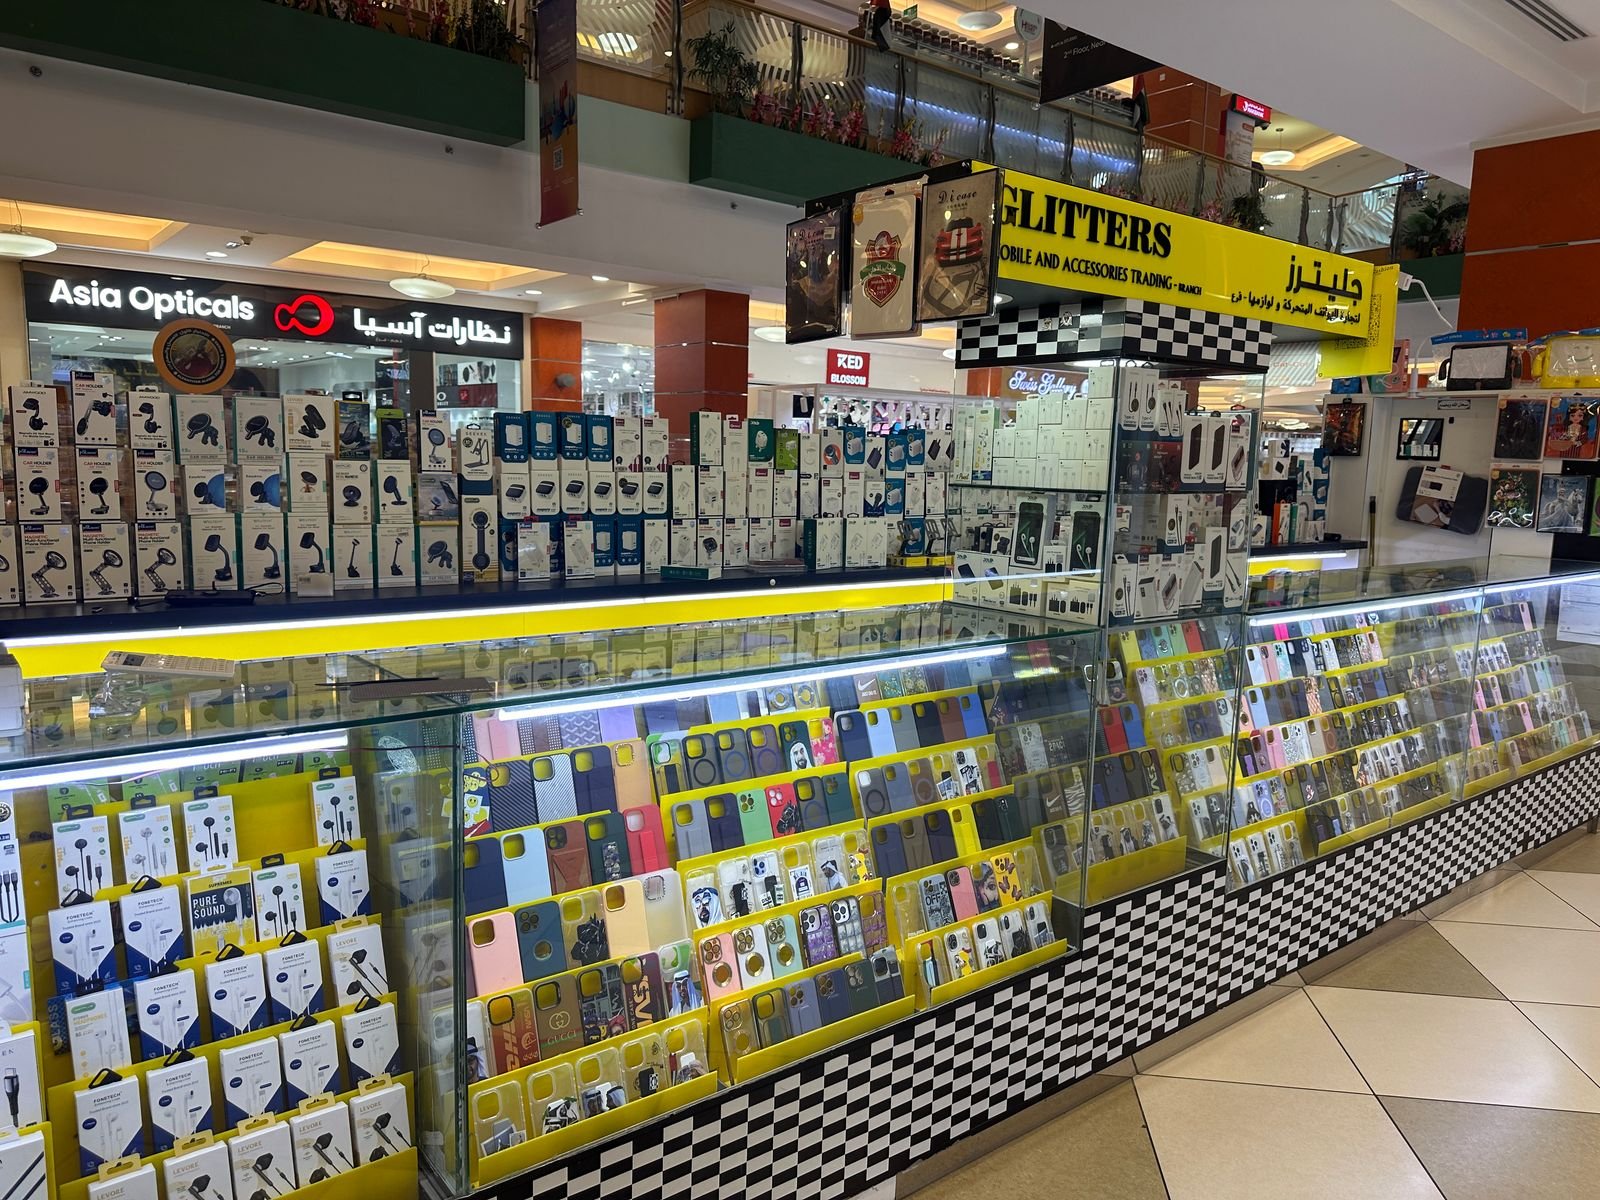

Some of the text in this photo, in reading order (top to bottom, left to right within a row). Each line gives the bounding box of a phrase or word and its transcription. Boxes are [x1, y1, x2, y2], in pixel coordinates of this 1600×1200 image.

[1072, 46, 1090, 56] Floor,
[1001, 184, 1171, 259] GLITTERS
[1000, 244, 1032, 264] OBILE
[1034, 251, 1060, 270] AND
[1062, 256, 1128, 282] ACCESSORIES
[1130, 269, 1172, 290] TRADING
[1178, 283, 1202, 296] BRANCH
[1286, 255, 1362, 306] جليترز
[50, 278, 255, 321] Asia Opticals
[354, 308, 511, 346] نظارات آسيا
[830, 374, 866, 386] BLOSSOM
[1009, 370, 1076, 400] Swiss Gallery
[208, 880, 232, 888] SUPREMES
[193, 894, 218, 909] PURE
[66, 912, 93, 920] FONETECH
[194, 902, 226, 919] SOUND
[335, 938, 357, 946] LEVORE
[223, 966, 247, 974] FONETECH
[153, 982, 179, 991] FONETECH
[360, 1016, 382, 1025] FONETECH
[298, 1035, 321, 1044] FONETECH
[546, 1030, 577, 1045] GUCCI
[239, 1052, 263, 1061] FONETECH
[166, 1072, 191, 1082] FONETECH
[93, 1093, 121, 1103] FONETECH
[360, 1101, 382, 1112] LEVORE
[300, 1121, 322, 1132] LEVORE
[237, 1141, 262, 1152] LEVORE
[172, 1162, 199, 1174] LEVORE
[96, 1187, 124, 1199] LEVORE
